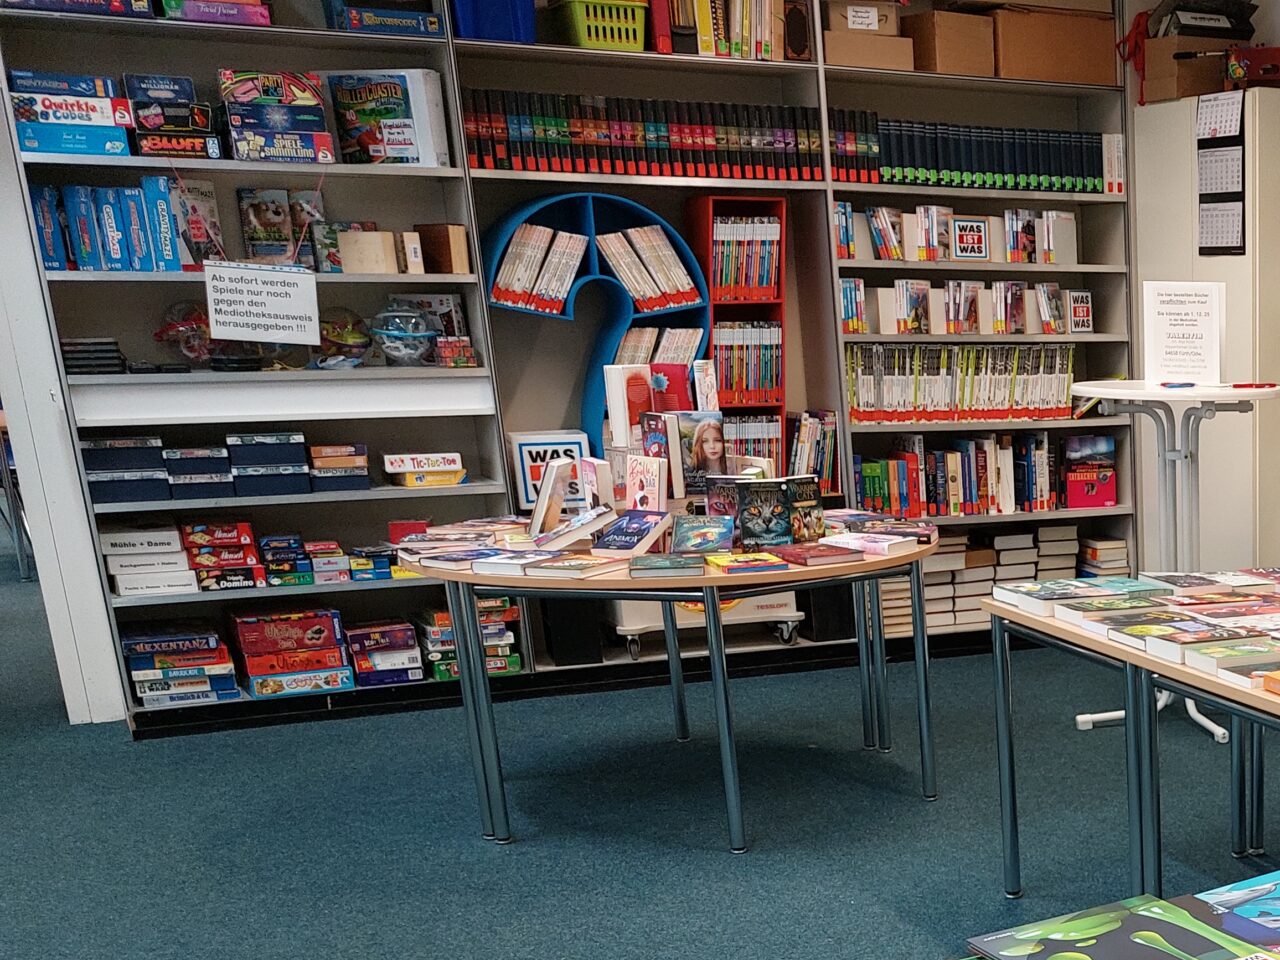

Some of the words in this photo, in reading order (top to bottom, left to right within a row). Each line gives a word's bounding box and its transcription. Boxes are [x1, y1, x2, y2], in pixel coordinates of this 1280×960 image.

[40, 98, 98, 114] Qwirkle
[958, 224, 982, 233] WAS
[963, 235, 979, 244] IST
[959, 245, 983, 254] WAS
[211, 274, 226, 283] Ab
[228, 276, 258, 285] sofort
[261, 280, 299, 288] werden
[212, 285, 244, 296] Spiele
[247, 289, 263, 297] nur
[266, 290, 291, 299] noch
[213, 298, 245, 307] gegen
[248, 299, 266, 307] den
[1072, 295, 1089, 304] WAS
[214, 308, 313, 322] Mediotheksausweis
[1076, 307, 1088, 317] IST
[215, 319, 294, 332] herausgegeben
[297, 324, 306, 332] !!!
[1073, 319, 1091, 329] WAS
[528, 449, 575, 463] WAS
[410, 456, 457, 470] Tic-Tac-Toe
[110, 540, 137, 549] Mühle
[147, 540, 172, 548] Dame
[220, 579, 254, 588] Domino
